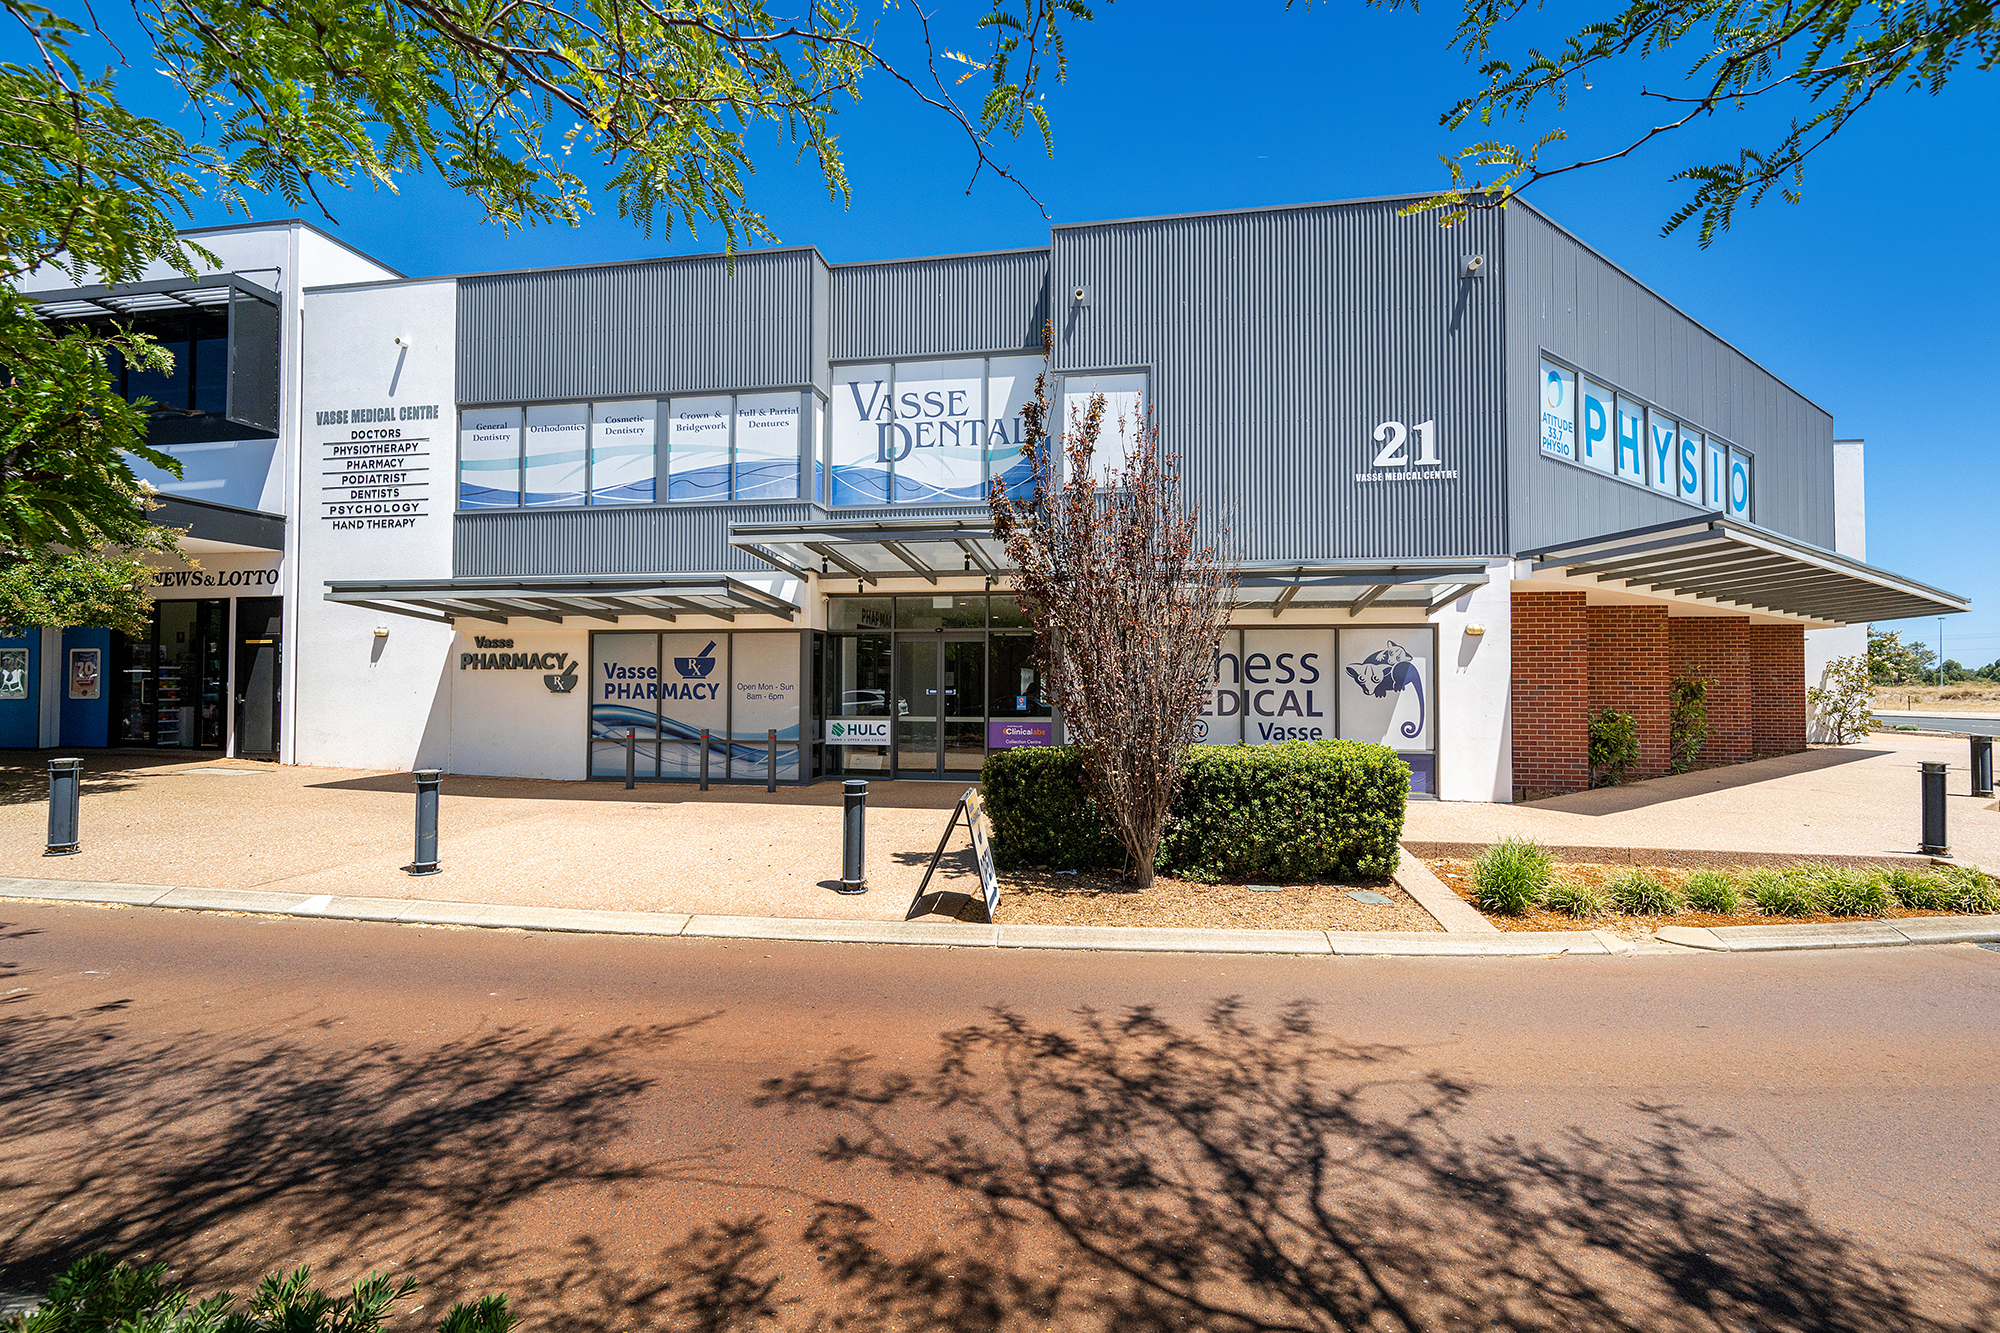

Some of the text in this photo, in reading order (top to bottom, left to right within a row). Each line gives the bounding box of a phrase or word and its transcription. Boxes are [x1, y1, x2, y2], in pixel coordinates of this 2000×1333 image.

[848, 380, 970, 421] VASSE
[316, 405, 439, 426] VASSE MEDICAL CENTRE
[680, 410, 723, 420] Crown &
[739, 406, 799, 417] Full & Partial
[605, 415, 645, 424] Cosmetic
[748, 420, 790, 429] Dentures
[1541, 411, 1573, 434] ATITUDE
[476, 422, 508, 431] General
[530, 424, 586, 433] Orthodontics
[605, 426, 645, 436] Dentistry
[676, 421, 727, 433] Bridgework
[351, 428, 401, 440] DOCTORS
[473, 433, 511, 443] Dentistry
[1548, 426, 1563, 441] 33.7
[875, 418, 1026, 464] DENTAL
[1373, 420, 1442, 467] 21
[1542, 436, 1570, 455] PHYSIO
[333, 442, 419, 456] PHYSIOTHERAPY
[1584, 394, 1748, 513] PHYSIO
[346, 458, 405, 470] PHARMACY
[341, 473, 407, 485] PODIATRIST
[1355, 470, 1458, 482] VASSE MEDICAL CENTRE
[350, 488, 400, 499] DENTISTS
[329, 503, 420, 515] PSYCHOLOGY
[332, 518, 416, 530] HAND THERAPY
[474, 636, 514, 648] Vasse
[460, 653, 568, 670] PHARMACY
[603, 663, 657, 679] Vasse
[1214, 652, 1320, 684] ness
[604, 683, 720, 700] PHARMACY
[737, 683, 756, 691] Open
[768, 693, 785, 701] 6pm
[1200, 690, 1323, 717] EDICAL
[848, 724, 887, 736] HULC
[1257, 722, 1323, 741] Vasse
